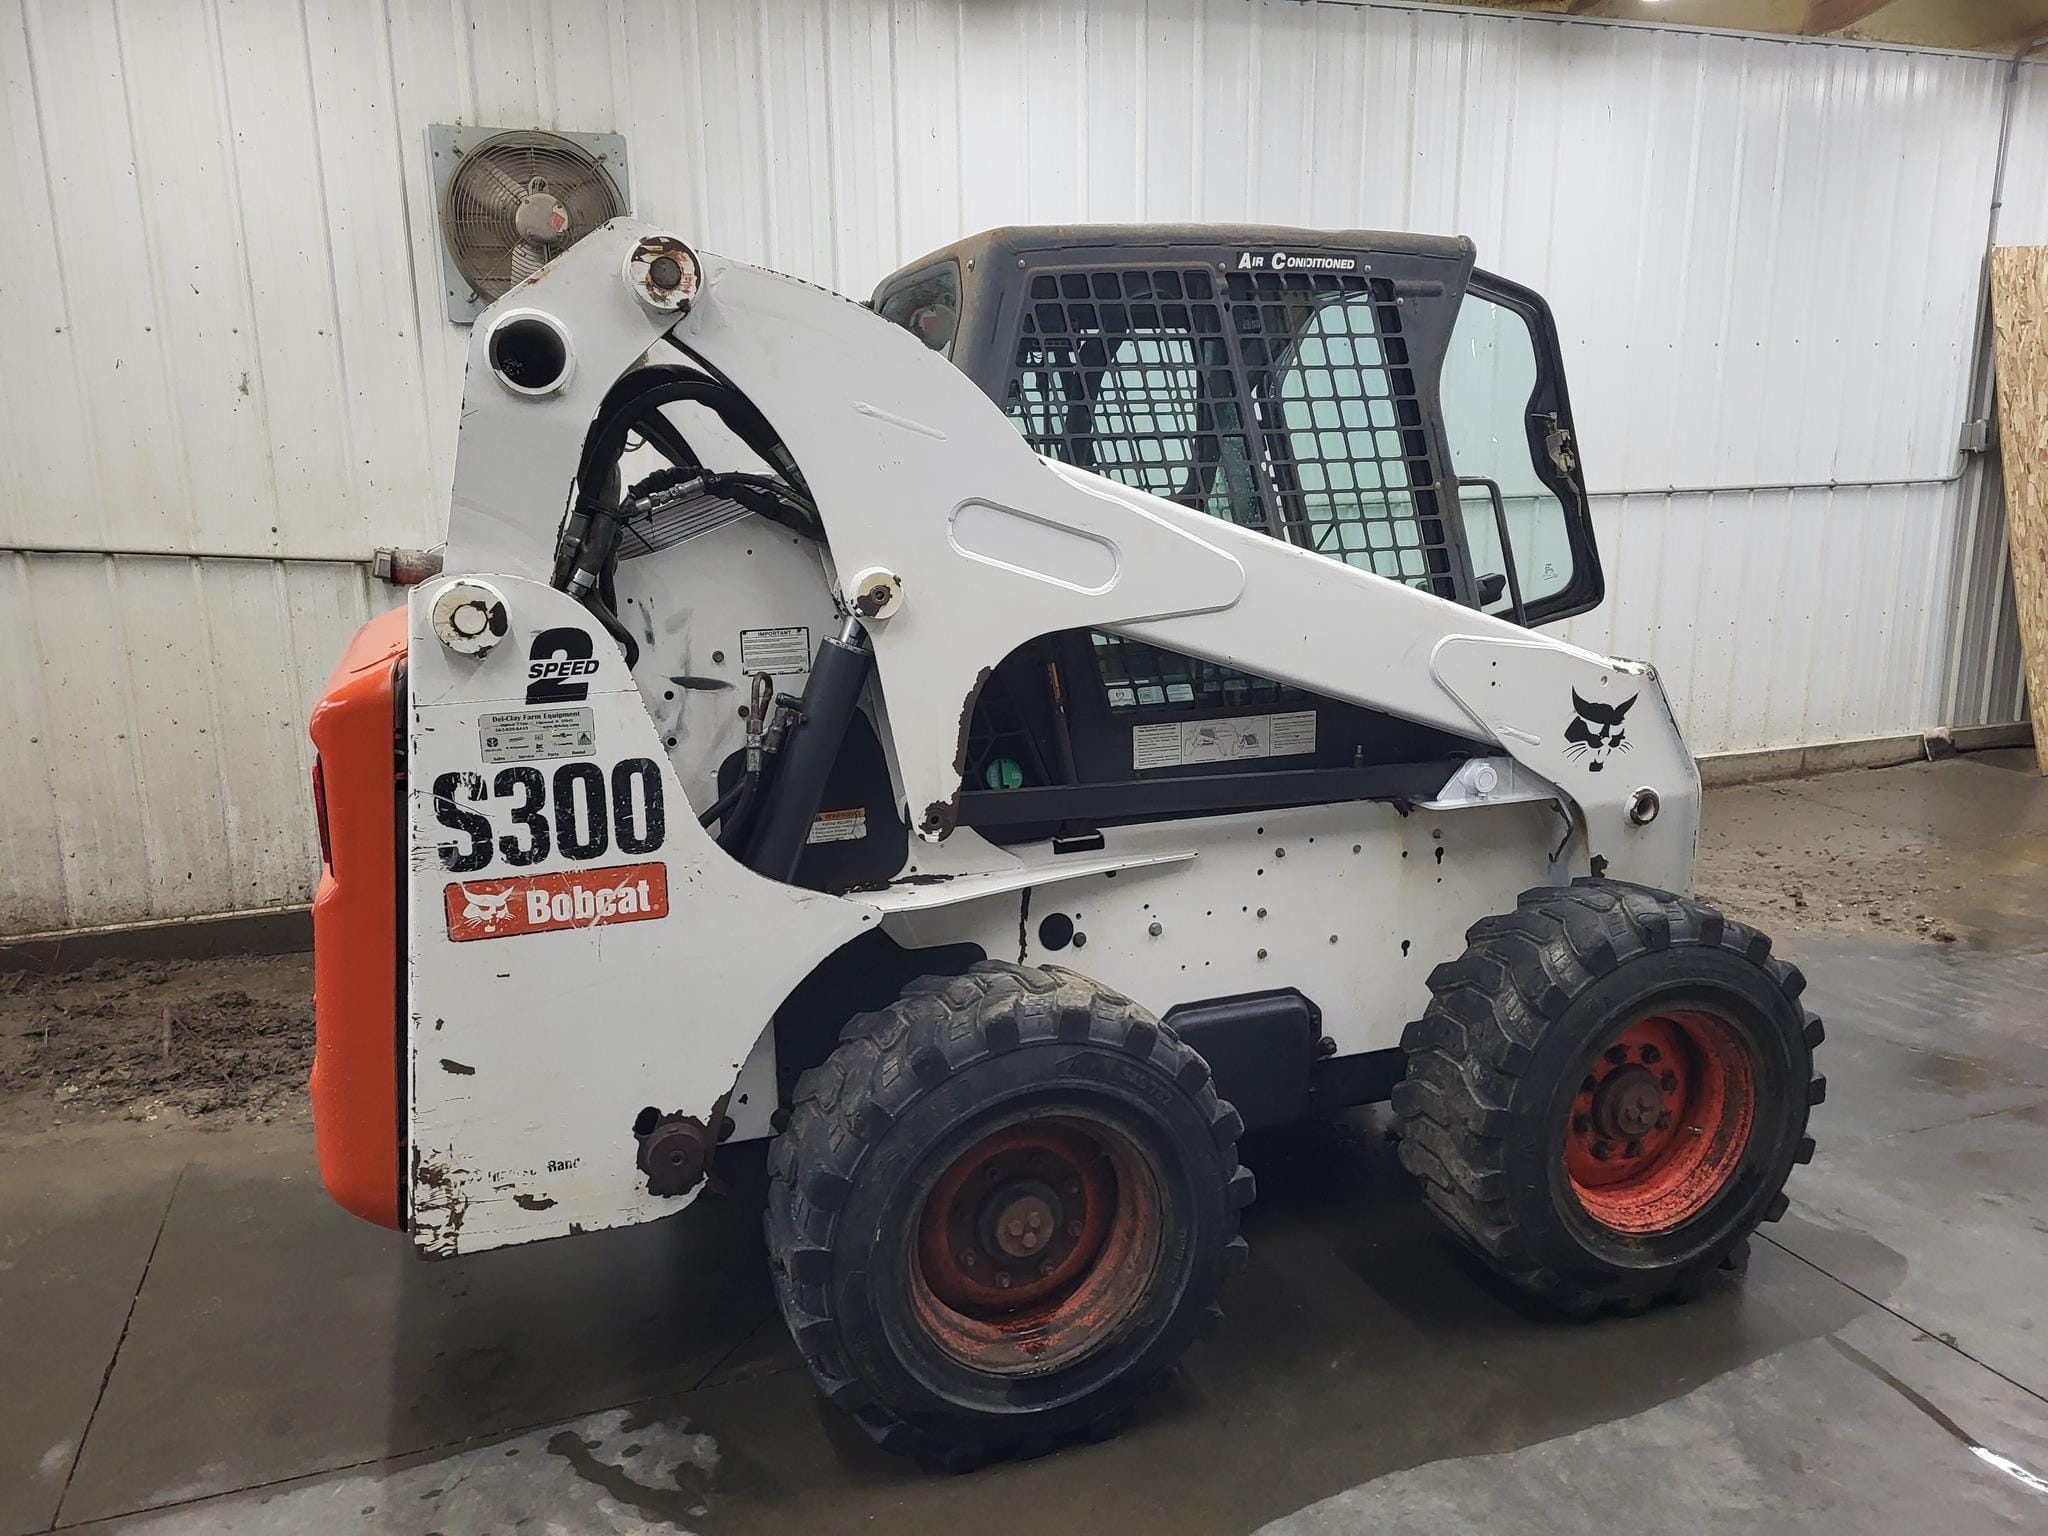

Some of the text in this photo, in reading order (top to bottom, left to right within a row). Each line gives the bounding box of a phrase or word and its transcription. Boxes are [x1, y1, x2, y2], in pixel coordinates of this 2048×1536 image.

[1238, 252, 1355, 270] AIR CONDITIONED
[525, 627, 593, 705] 2
[527, 659, 600, 679] SPEED
[492, 711, 580, 723] Del-Clay Farm Equipment
[433, 757, 666, 873] S300
[526, 879, 651, 926] Bobcat
